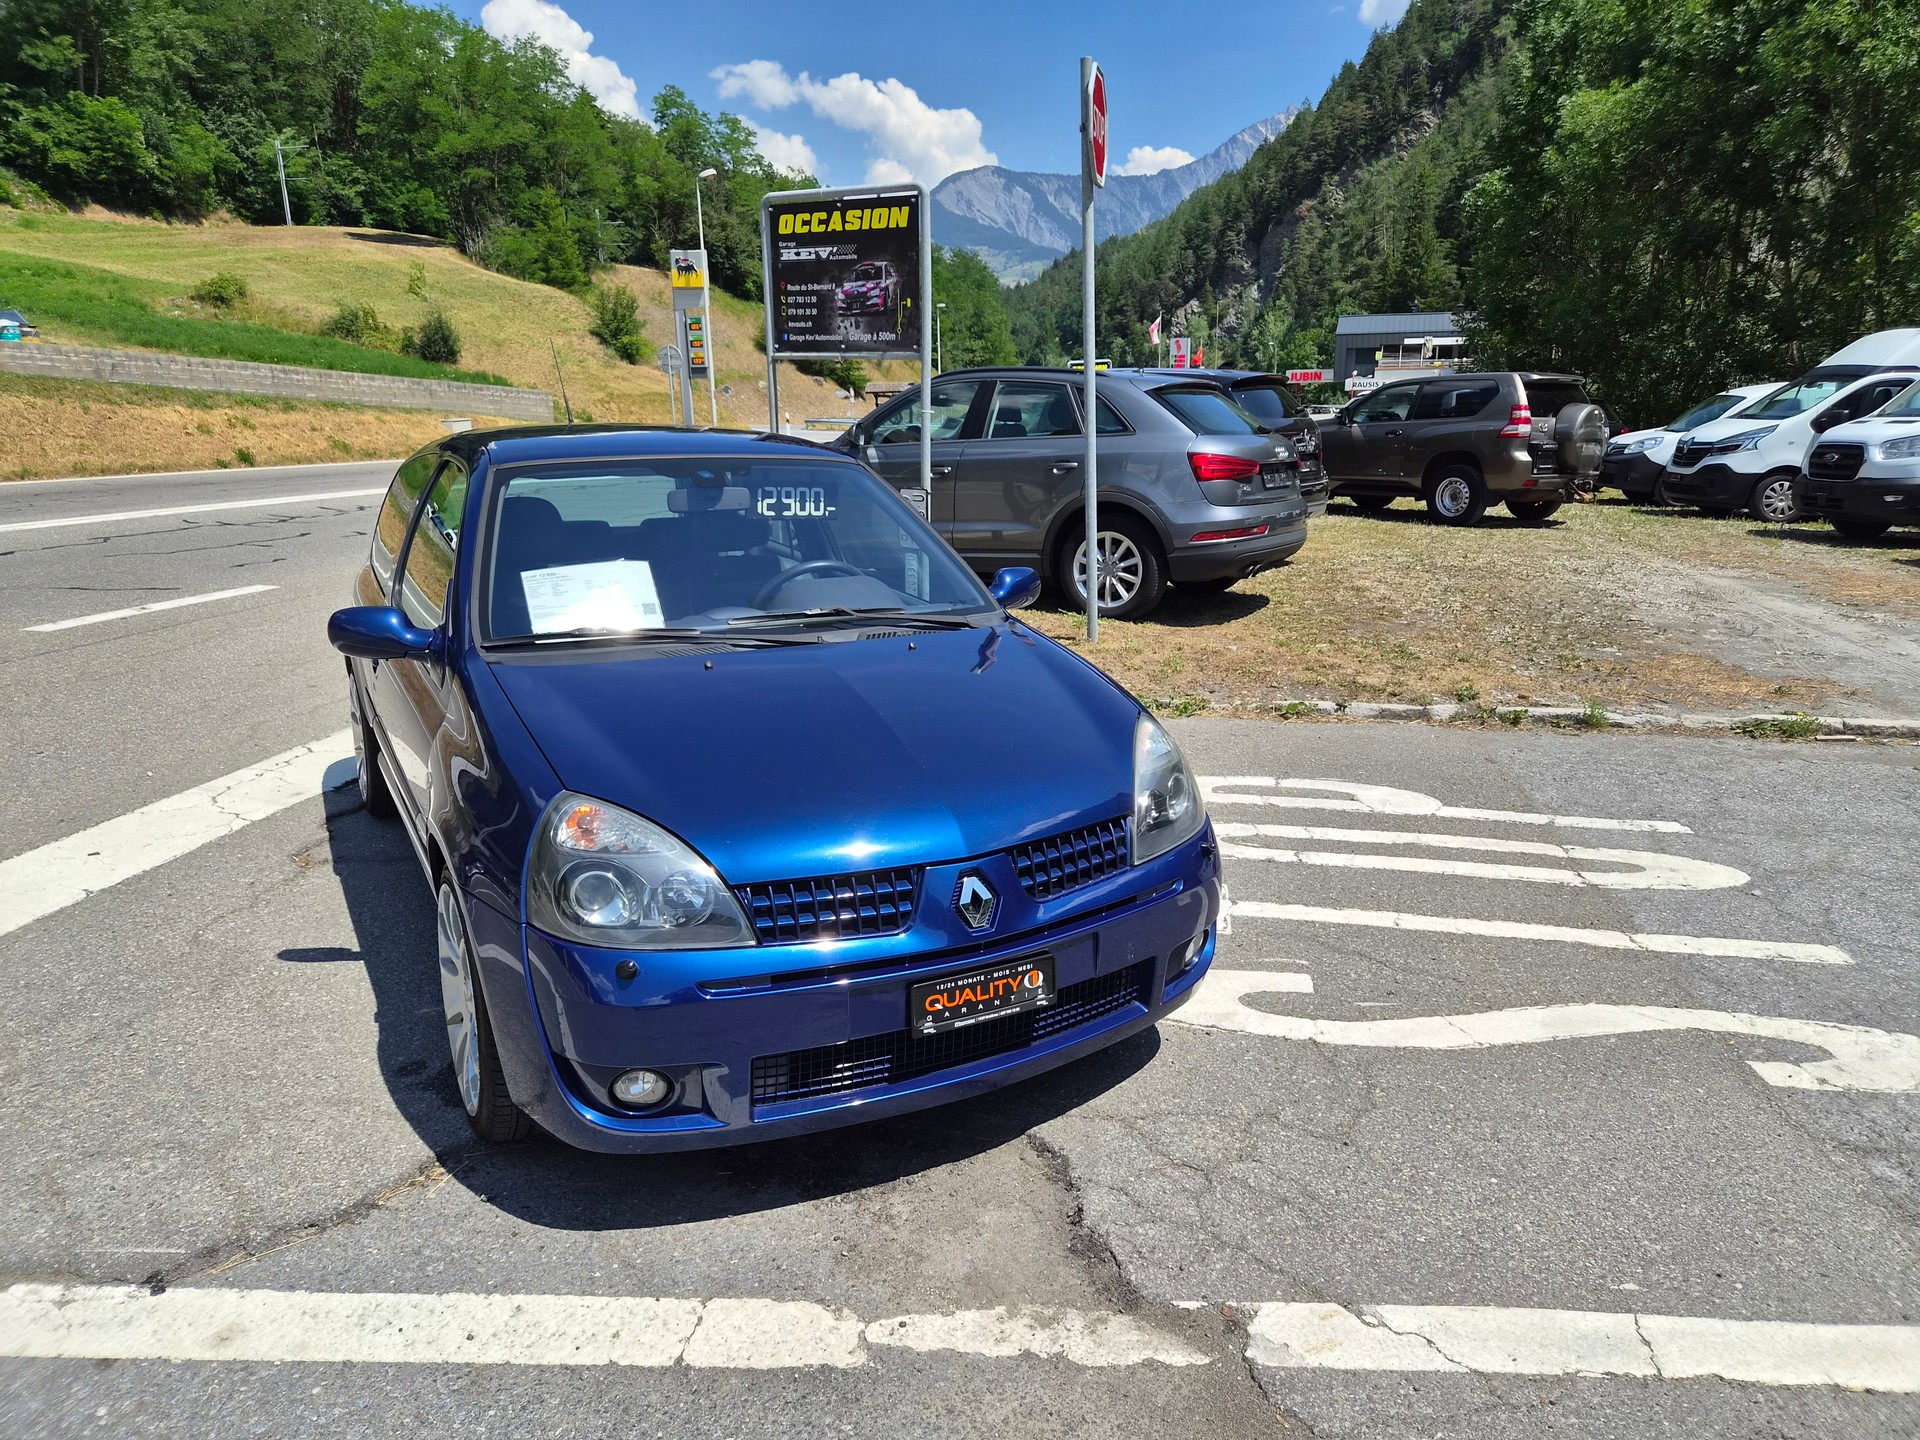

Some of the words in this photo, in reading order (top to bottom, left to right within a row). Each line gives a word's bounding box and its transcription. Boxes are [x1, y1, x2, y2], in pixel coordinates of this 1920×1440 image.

[1093, 104, 1105, 147] STOP
[778, 206, 910, 235] OCCASION
[787, 283, 801, 291] Route
[802, 283, 807, 291] du
[789, 334, 806, 342] Garage
[849, 333, 871, 343] Garage
[872, 332, 877, 340] à
[878, 332, 896, 341] 500m
[1290, 371, 1323, 382] JUBIN
[936, 981, 956, 991] 12/24
[957, 975, 985, 986] MONATE
[993, 969, 1010, 979] MOIS
[1018, 963, 1034, 973] MESI
